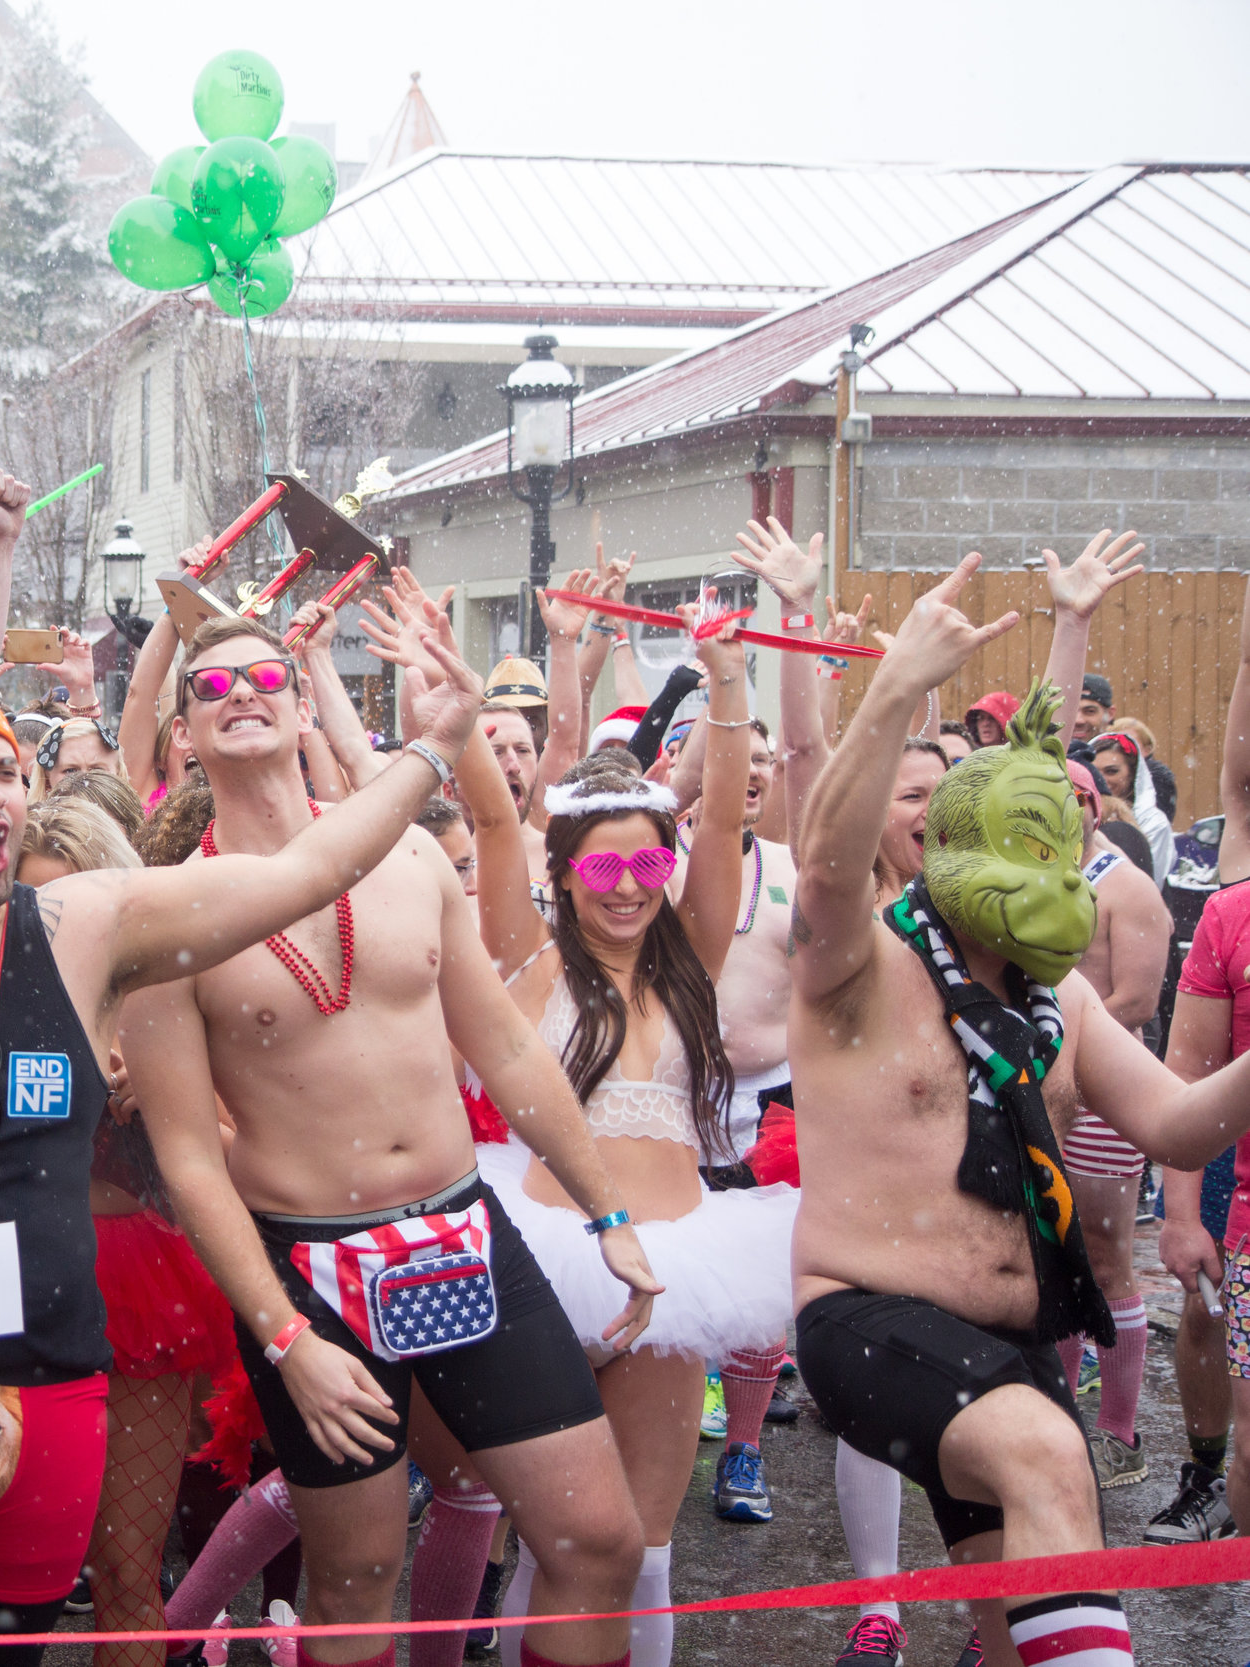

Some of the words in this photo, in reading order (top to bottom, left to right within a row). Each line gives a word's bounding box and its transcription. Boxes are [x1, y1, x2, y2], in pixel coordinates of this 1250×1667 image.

[240, 70, 260, 87] Dirty
[240, 82, 272, 98] Martinis
[15, 1058, 64, 1078] END
[15, 1083, 65, 1112] NF
[277, 1228, 346, 1242] OCKEY
